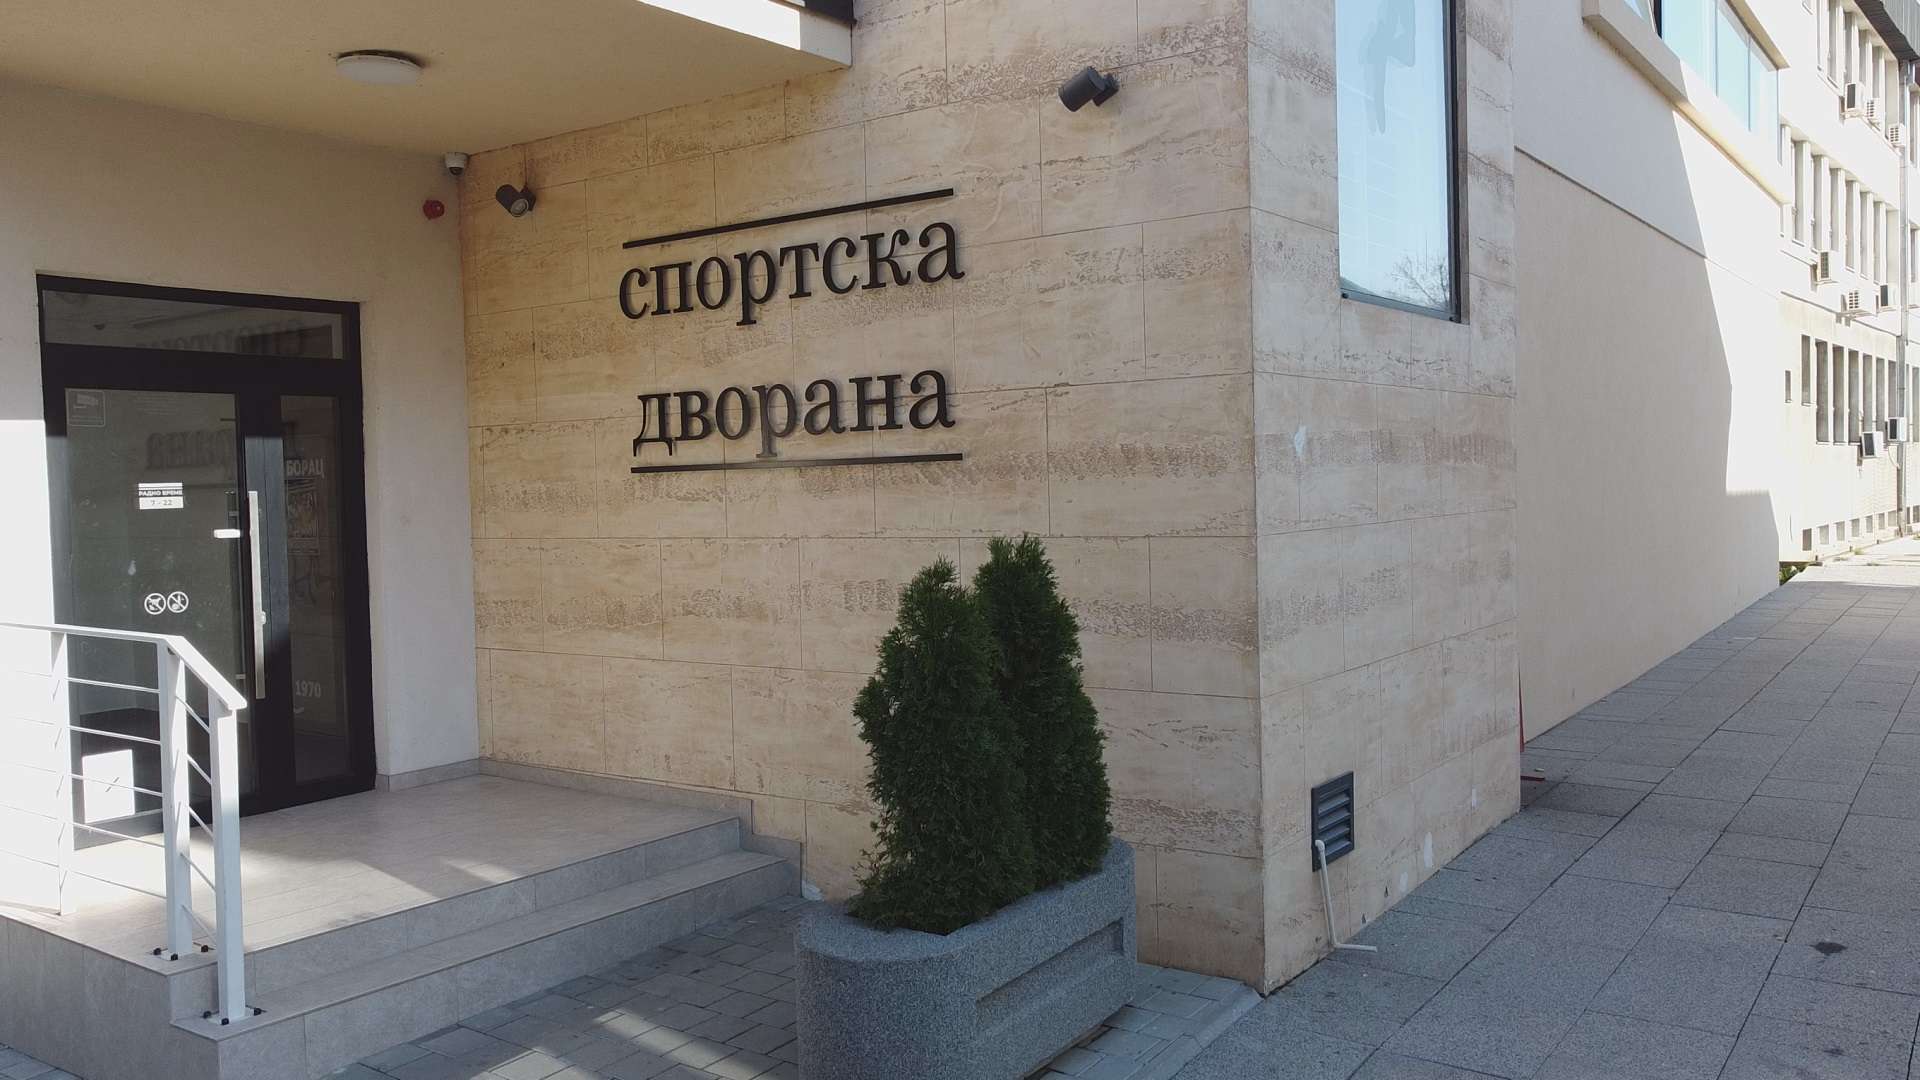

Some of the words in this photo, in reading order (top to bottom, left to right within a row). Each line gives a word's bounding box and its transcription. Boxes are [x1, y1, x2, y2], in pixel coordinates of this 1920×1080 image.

[619, 221, 965, 326] спортска
[632, 369, 956, 458] дворана
[295, 679, 321, 698] 1970
